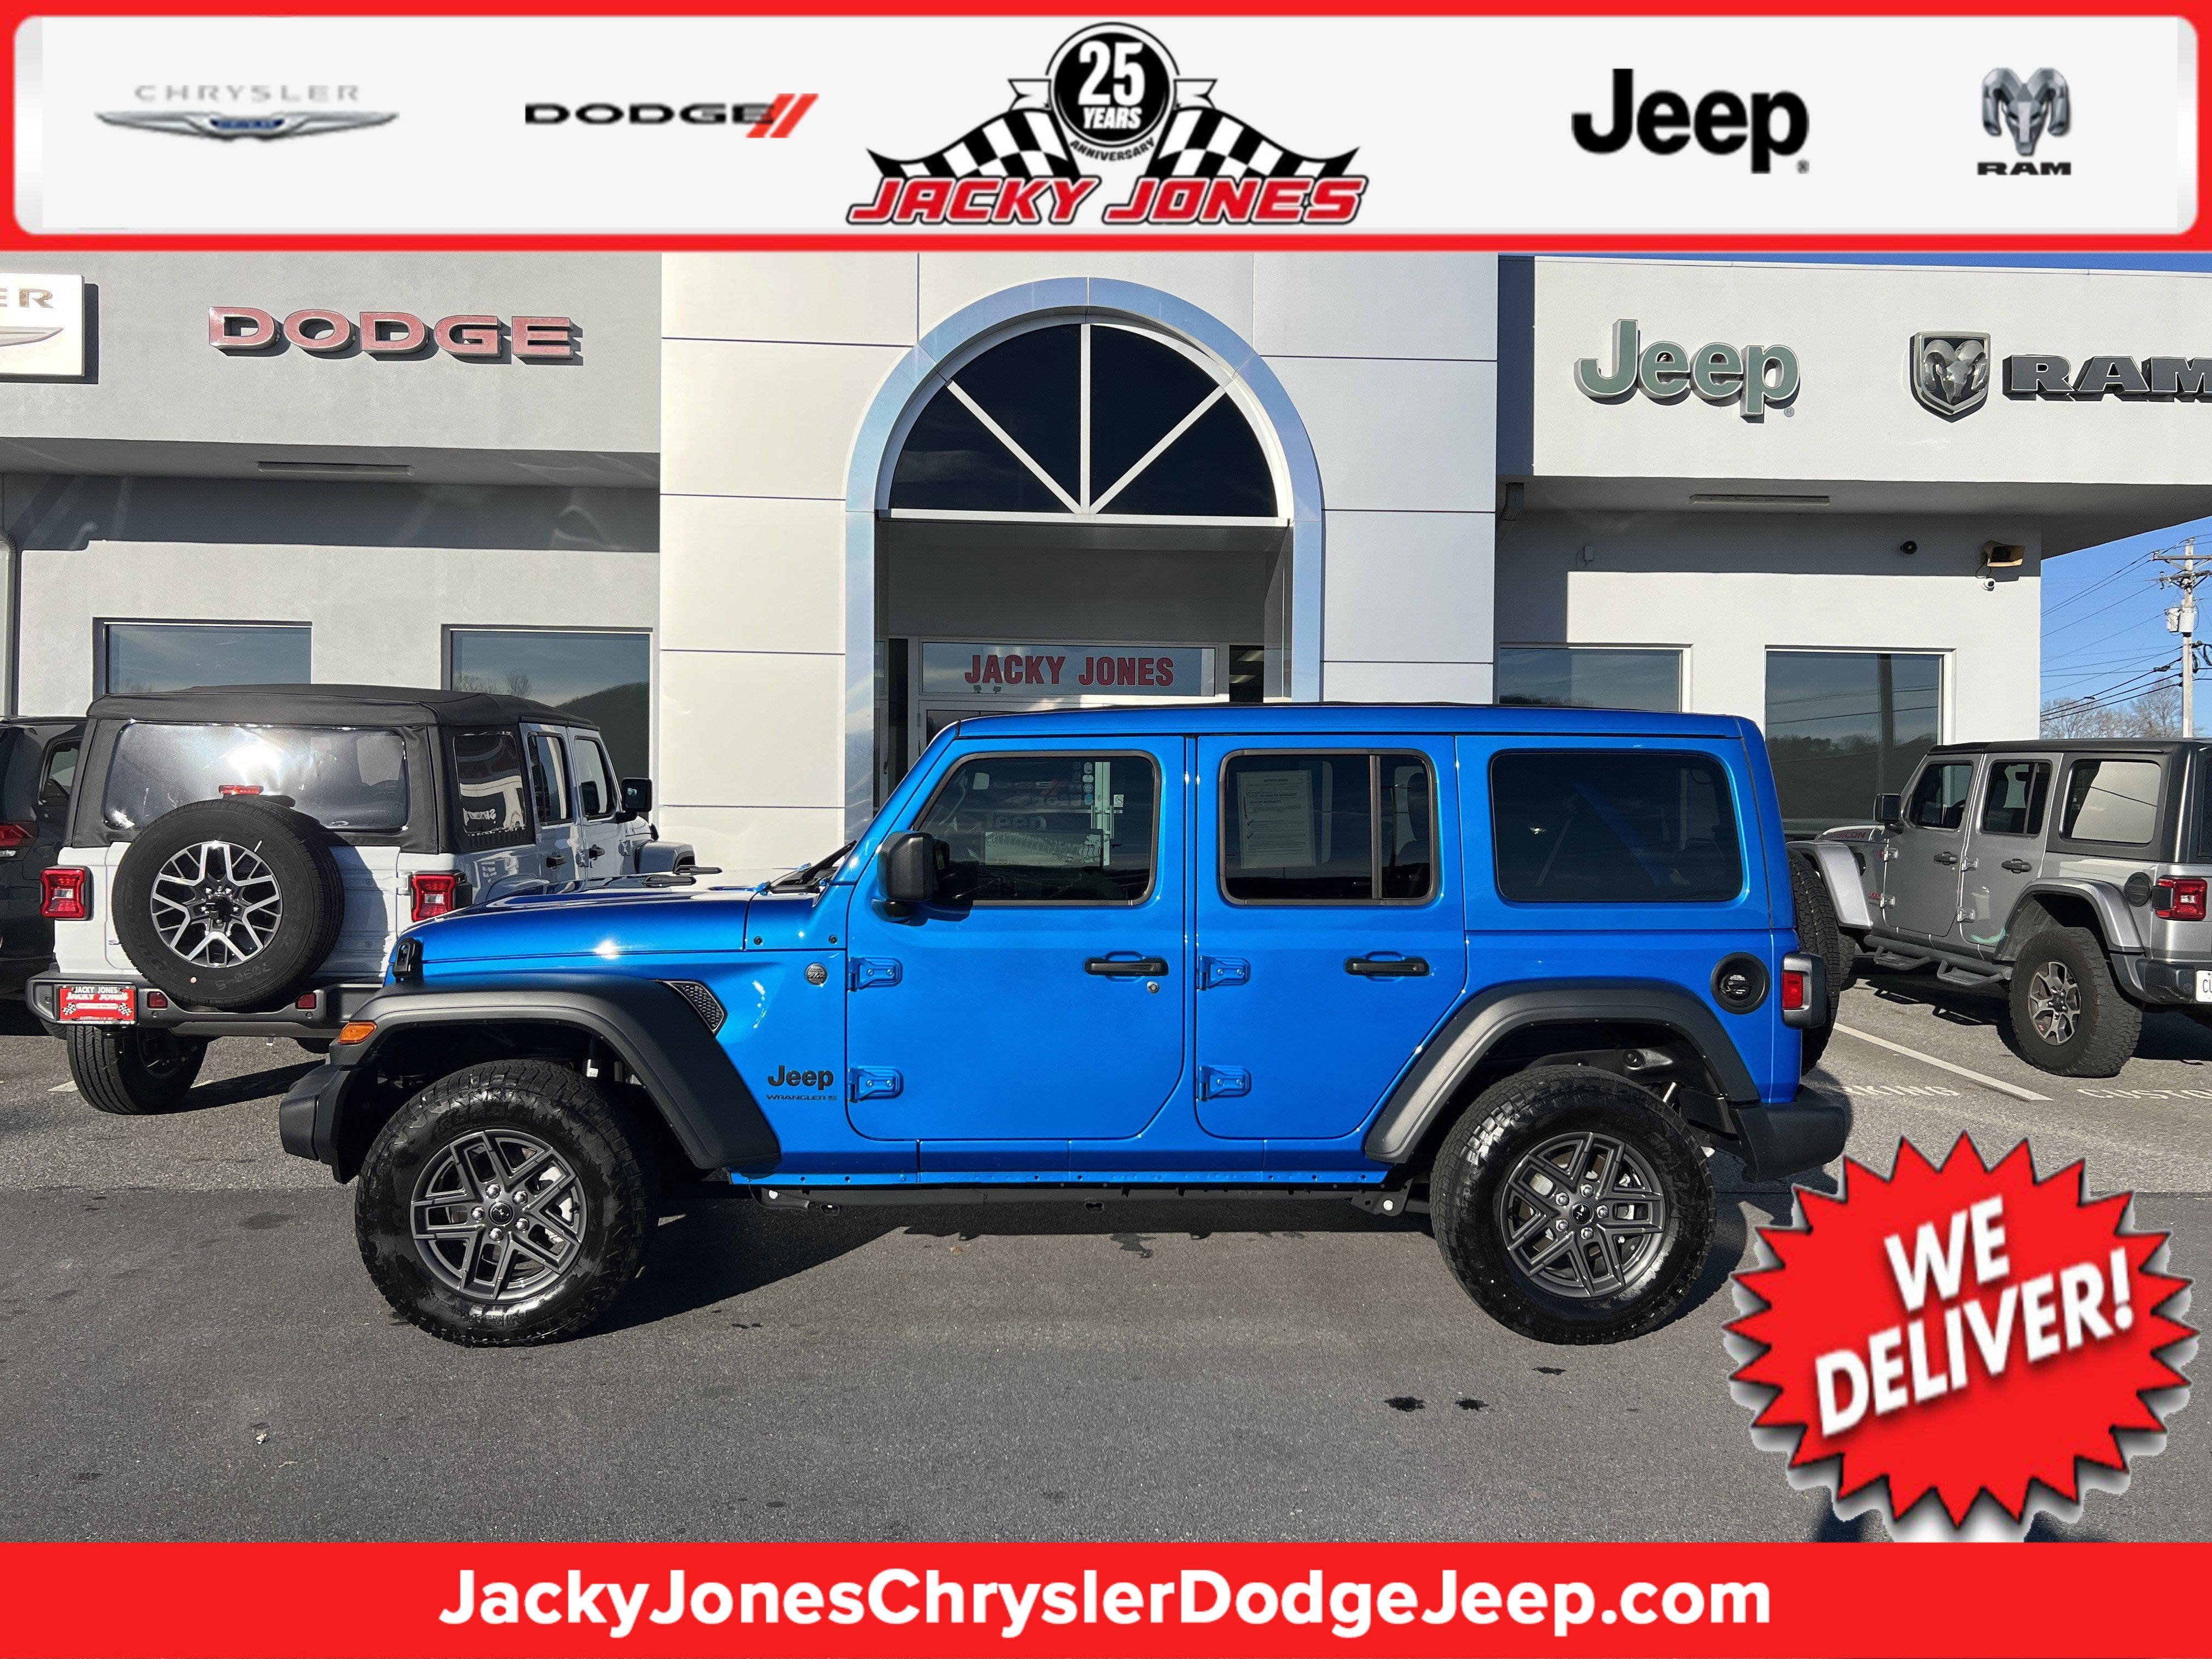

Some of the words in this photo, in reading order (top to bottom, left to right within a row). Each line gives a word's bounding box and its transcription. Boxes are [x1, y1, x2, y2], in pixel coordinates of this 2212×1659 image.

[209, 306, 574, 360] DODGE
[1576, 318, 1800, 417] Jeep
[2005, 354, 2212, 395] RAM
[964, 654, 1066, 685] JACKY
[1078, 656, 1174, 687] JONES
[768, 1065, 834, 1090] Jeep
[2076, 1088, 2212, 1099] CUSTO
